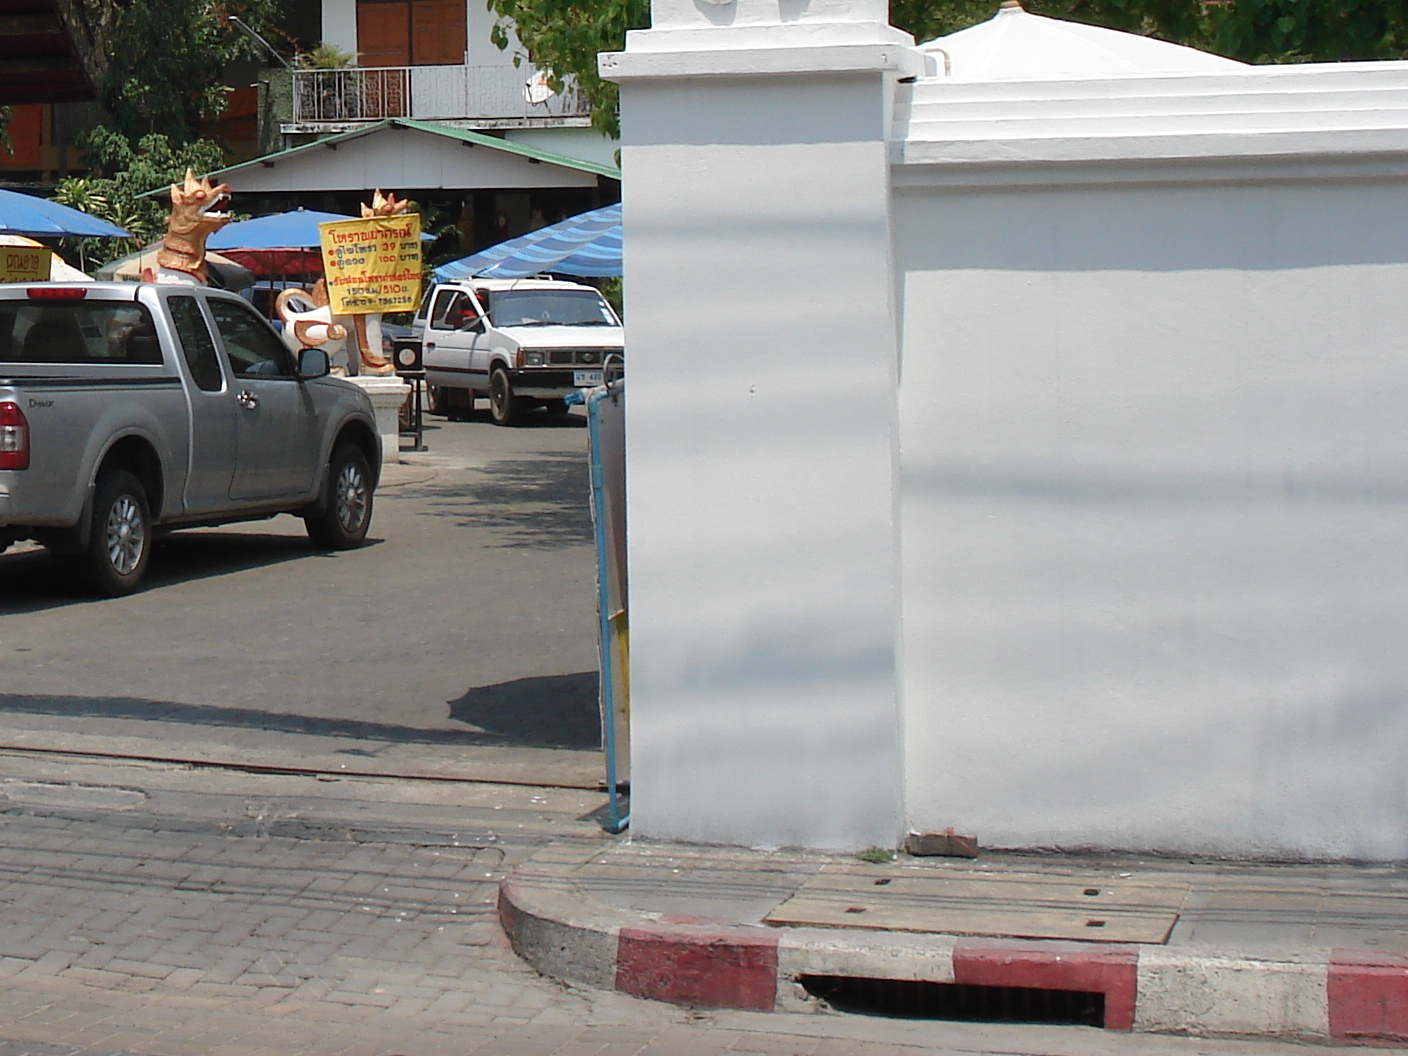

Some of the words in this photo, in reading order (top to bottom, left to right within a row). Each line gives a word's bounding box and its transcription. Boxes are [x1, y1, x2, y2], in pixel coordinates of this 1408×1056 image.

[328, 223, 412, 244] โหราพยากรณ์
[383, 243, 396, 251] 39
[379, 255, 396, 263] 100
